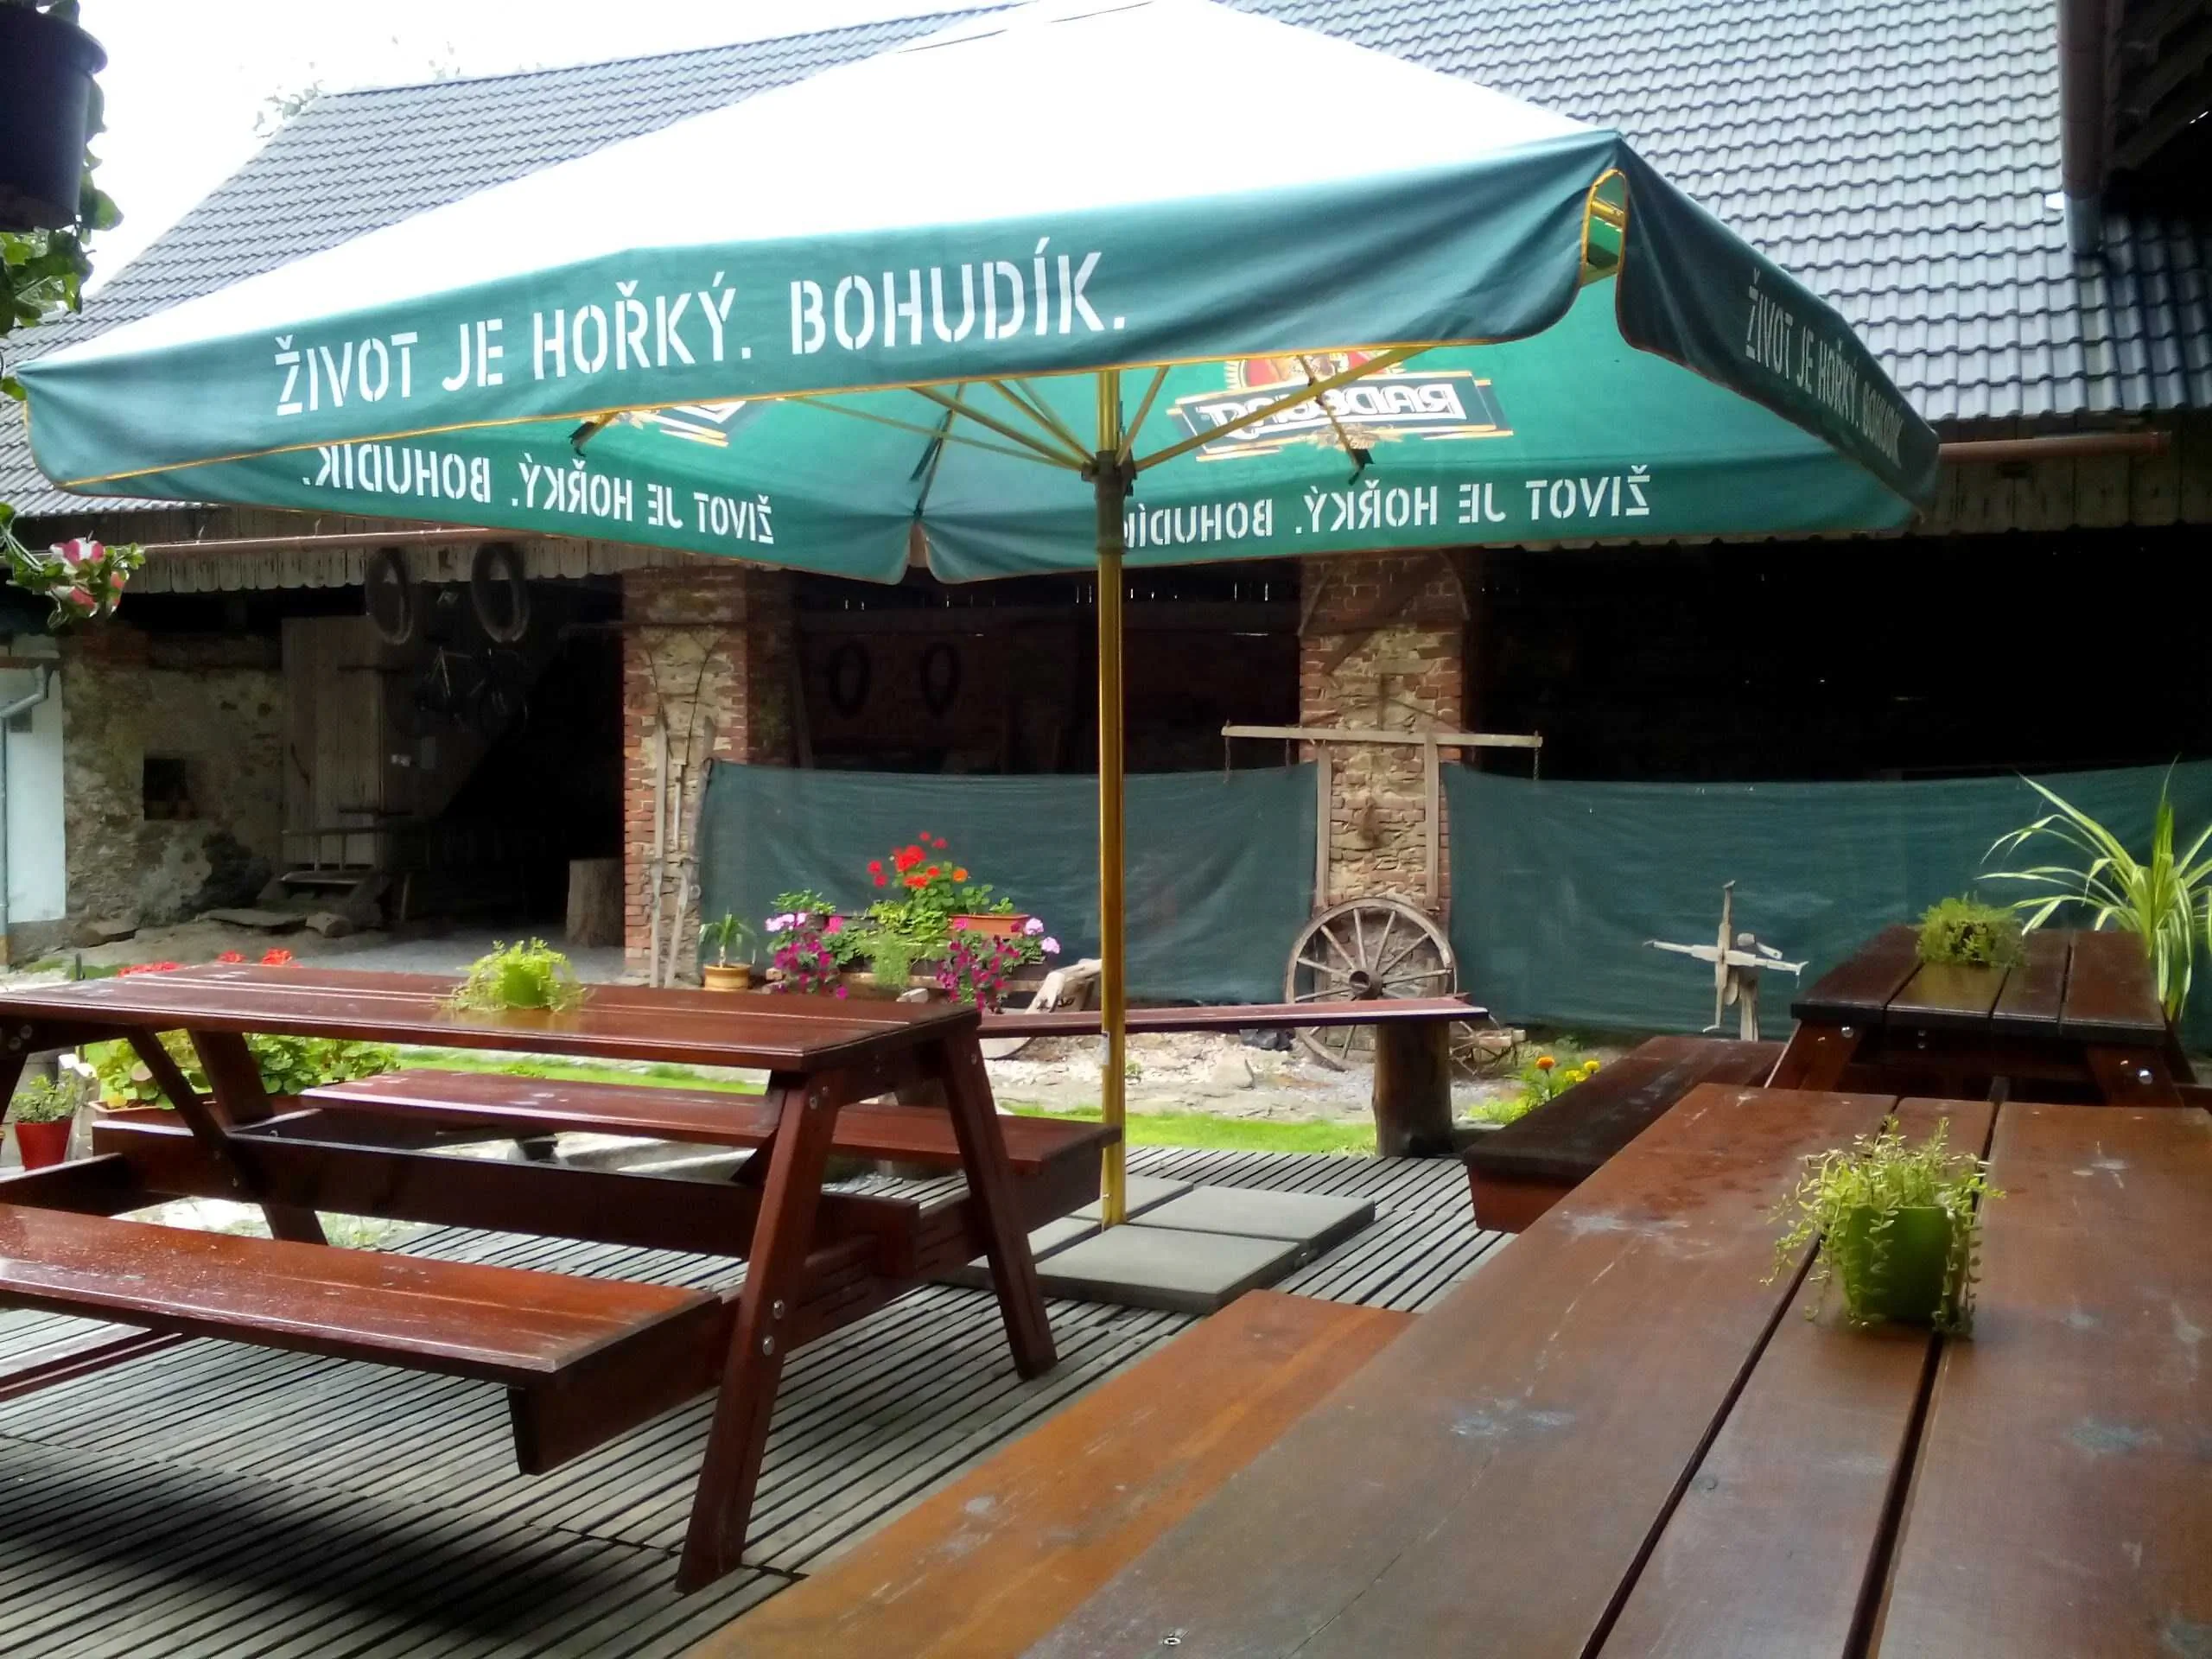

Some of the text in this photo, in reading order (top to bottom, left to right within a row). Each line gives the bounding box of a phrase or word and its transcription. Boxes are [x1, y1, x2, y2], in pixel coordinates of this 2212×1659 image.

[275, 236, 1127, 416] ŽIVOT JE HOŘKÝ. BOHUDÍK.
[1745, 266, 1794, 380] ŽIVOT
[1796, 324, 1815, 395] JE
